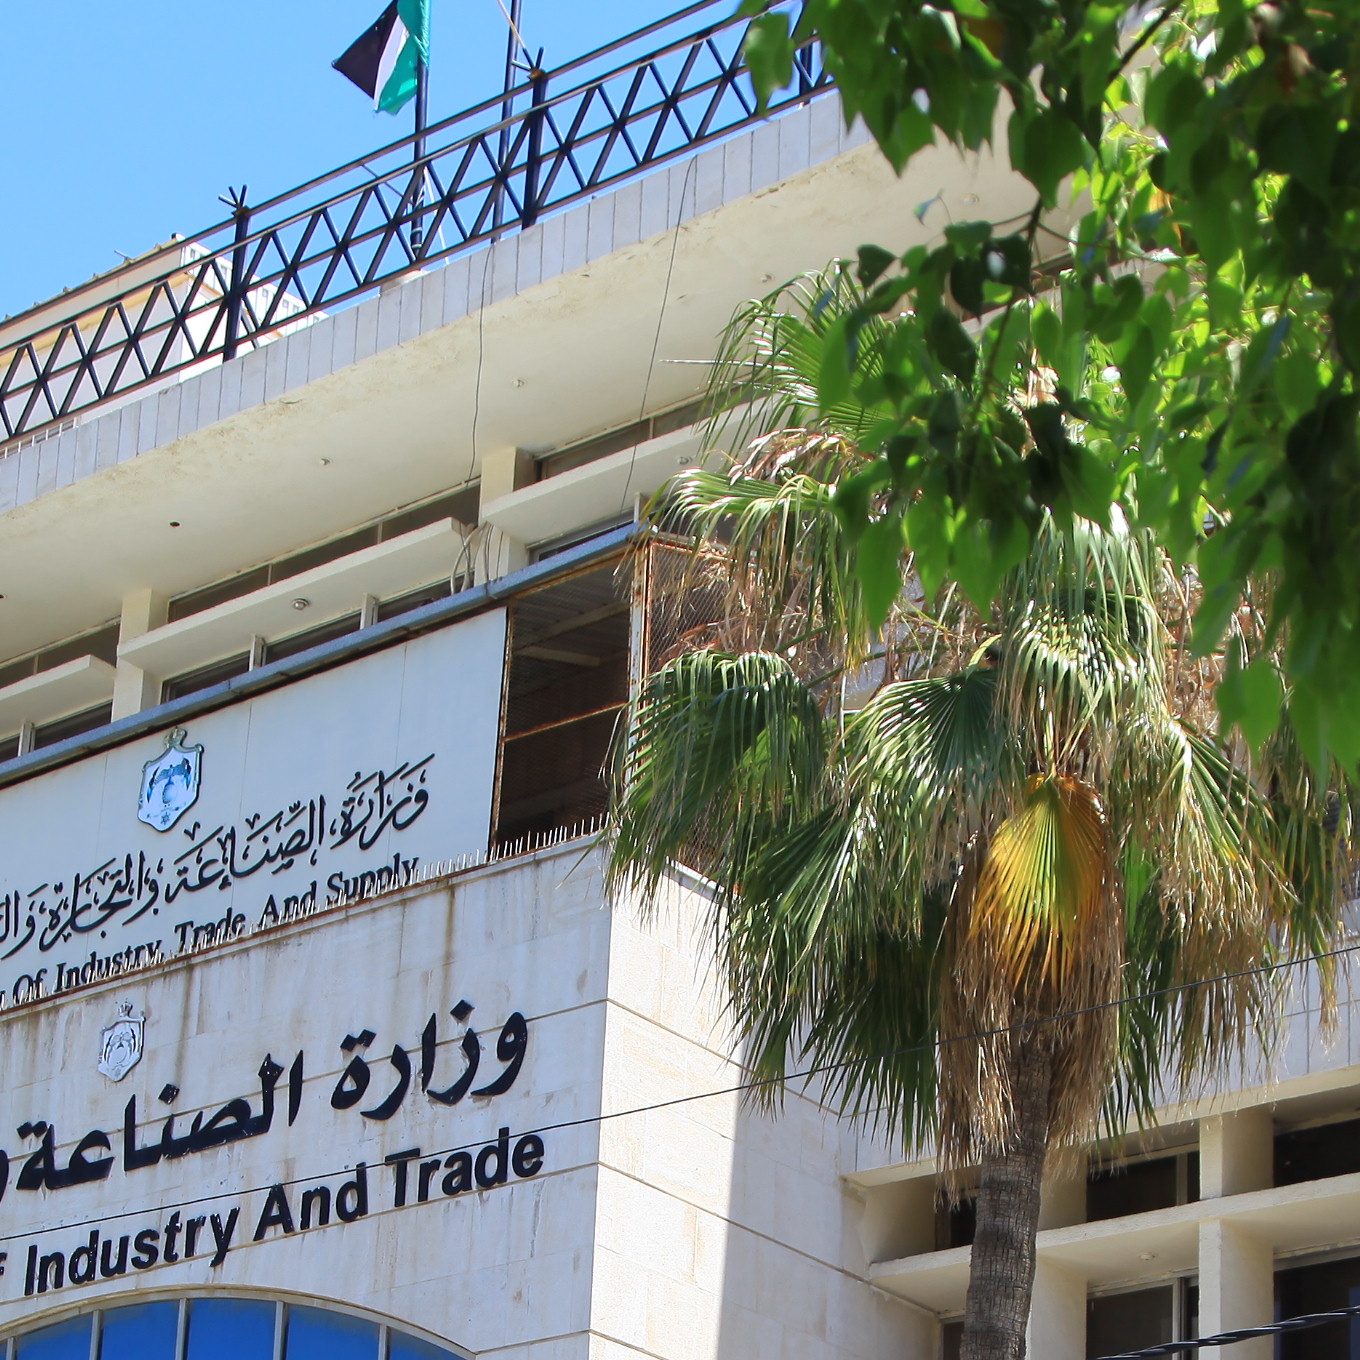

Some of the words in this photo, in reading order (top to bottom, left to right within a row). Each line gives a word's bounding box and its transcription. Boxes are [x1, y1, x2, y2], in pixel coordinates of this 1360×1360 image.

[13, 968, 47, 1002] Of
[174, 908, 246, 952] Trade
[259, 880, 318, 928] And
[326, 853, 419, 902] Supply
[16, 1050, 303, 1190] الصناعة
[331, 1000, 528, 1120] وزارة
[24, 1206, 240, 1296] Industry
[253, 1162, 368, 1241] And
[385, 1127, 544, 1207] Trade
